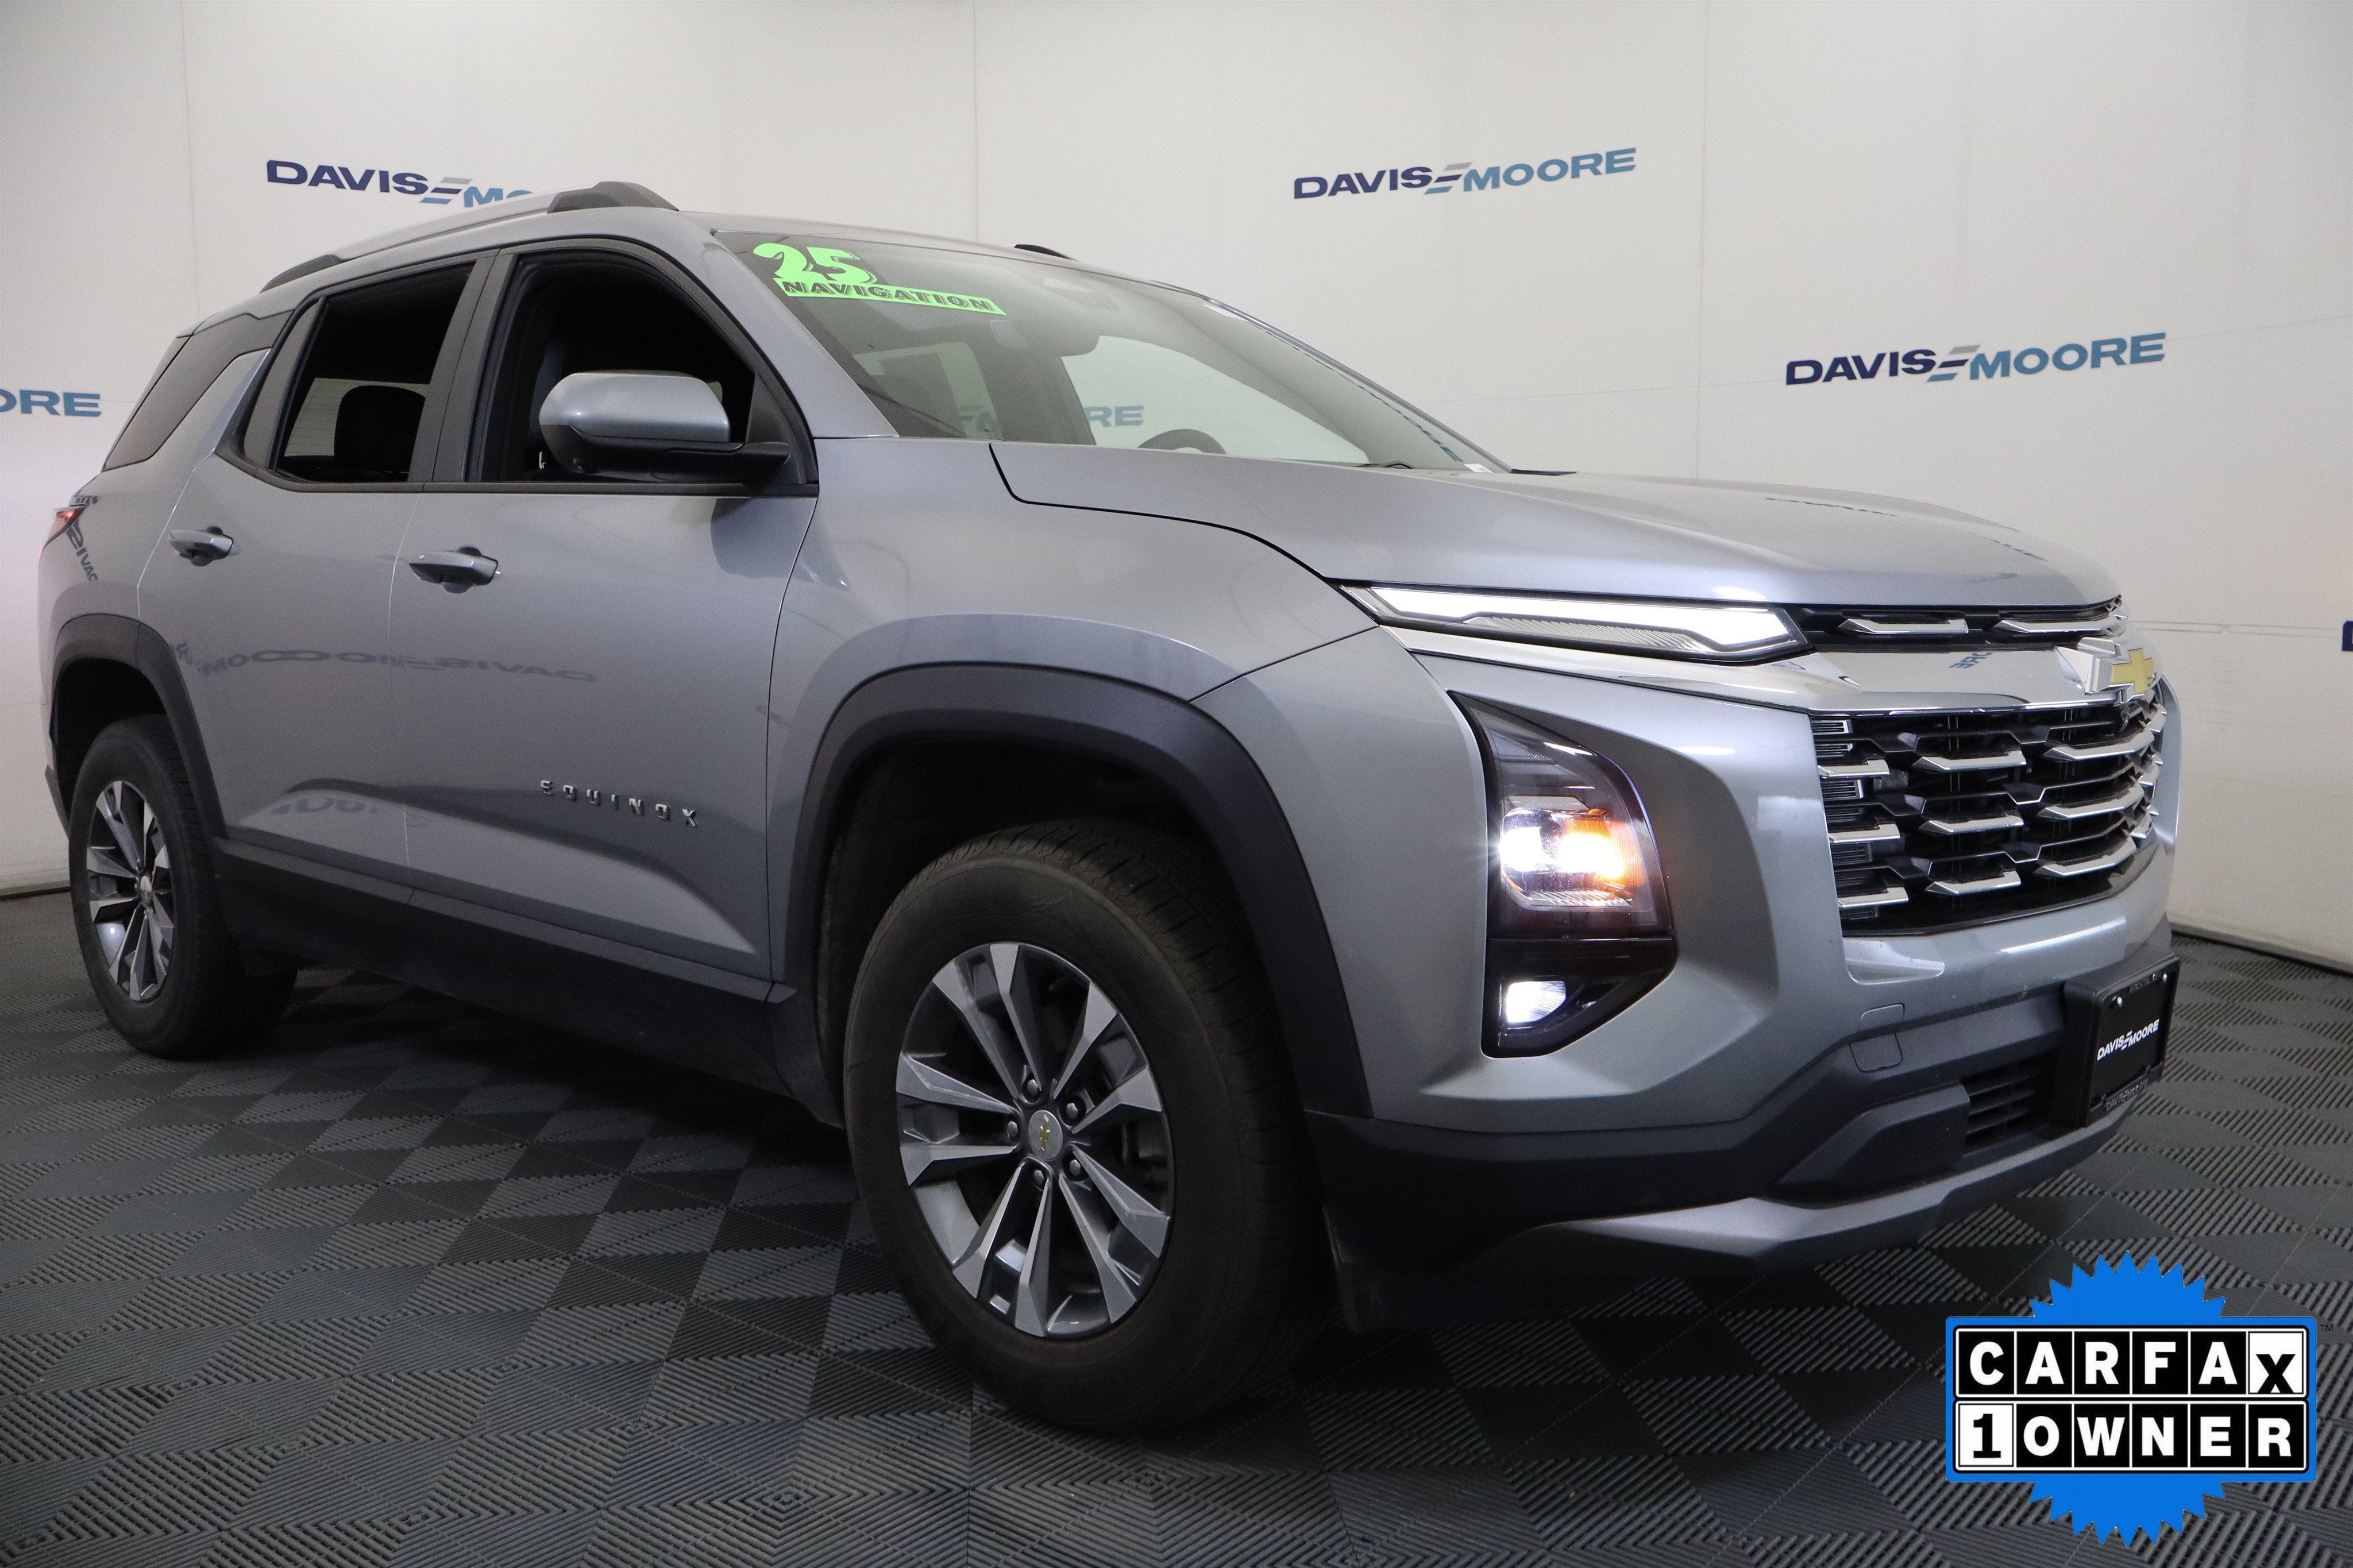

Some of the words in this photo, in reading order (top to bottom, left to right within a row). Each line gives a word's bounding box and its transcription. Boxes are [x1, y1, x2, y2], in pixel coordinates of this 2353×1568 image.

[267, 160, 429, 195] DAVIS
[1294, 167, 1433, 199] DAVIS
[1464, 148, 1636, 192] MOORE
[753, 243, 877, 284] 25
[781, 281, 994, 311] NAVIGATION
[1786, 349, 1937, 385] DAVIS
[1970, 332, 2166, 380] MOORE
[540, 780, 697, 827] EQUINOX
[2097, 1034, 2125, 1061] DAVIS
[2128, 1018, 2160, 1048] MOORE
